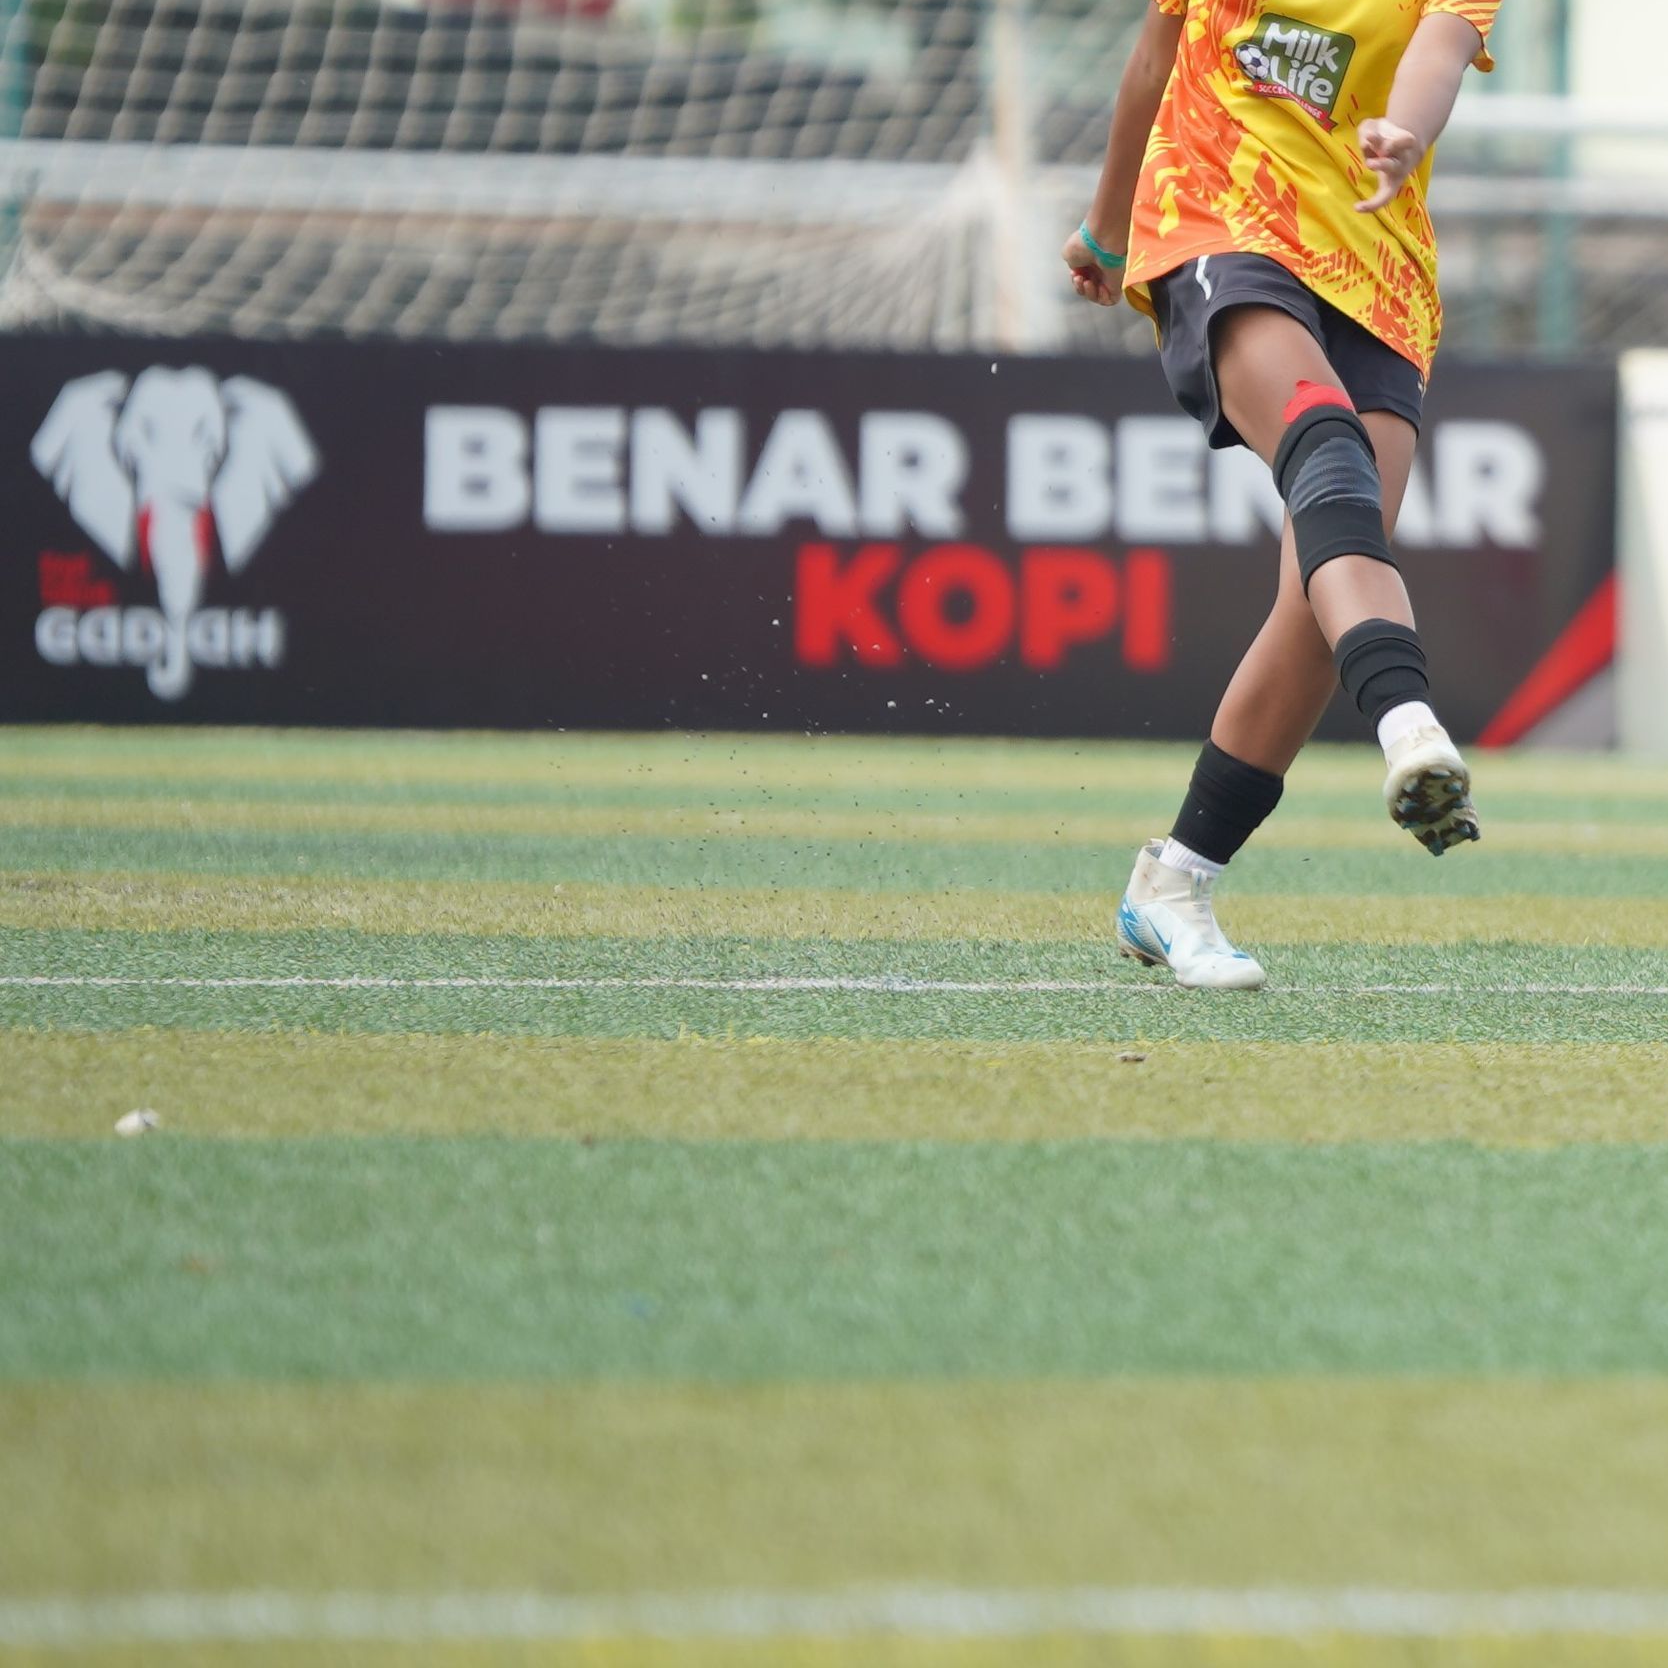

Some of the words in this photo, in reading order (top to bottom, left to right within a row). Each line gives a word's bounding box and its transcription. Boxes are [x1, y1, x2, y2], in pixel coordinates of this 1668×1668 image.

[1262, 22, 1340, 73] Milk
[1270, 55, 1334, 105] Life
[424, 405, 970, 536] BENAR
[796, 542, 1171, 671] KOPI
